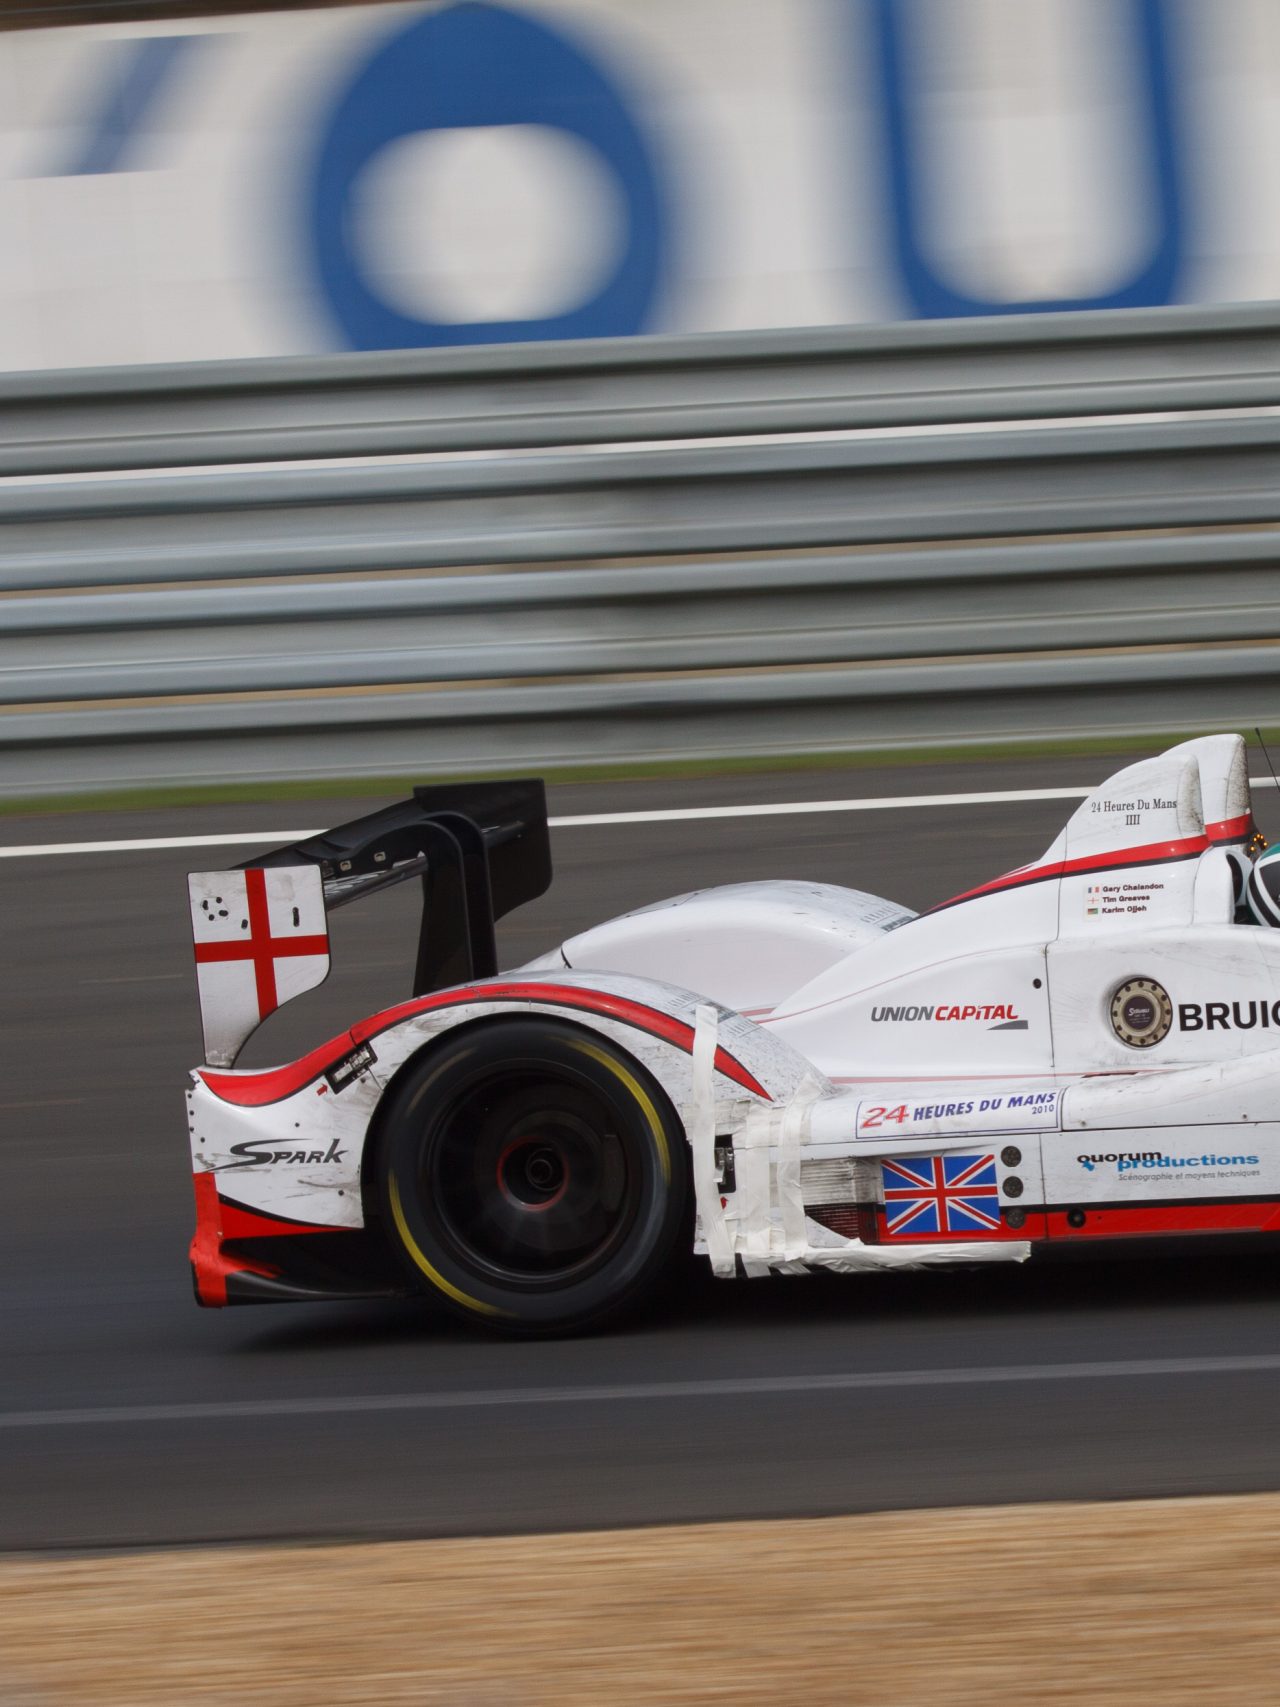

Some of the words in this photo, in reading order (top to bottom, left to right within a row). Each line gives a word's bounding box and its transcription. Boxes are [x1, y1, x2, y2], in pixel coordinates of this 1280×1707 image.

[1091, 802, 1101, 813] 24
[1104, 800, 1135, 812] Heures
[1137, 799, 1150, 810] Du
[1152, 798, 1178, 810] Mans
[1122, 883, 1164, 891] Chalandon
[1101, 906, 1125, 914] Karim
[859, 1104, 910, 1129] 24
[912, 1101, 975, 1122] HEURES
[978, 1098, 1003, 1112] DU
[1006, 1092, 1057, 1109] MANS
[1031, 1103, 1055, 1115] 2010
[1076, 1151, 1162, 1169] quorum
[1117, 1153, 1260, 1173] productions
[1118, 1171, 1173, 1183] Scénographie
[1175, 1172, 1183, 1180] et
[1184, 1172, 1216, 1182] moyens
[1217, 1168, 1261, 1180] techniques
